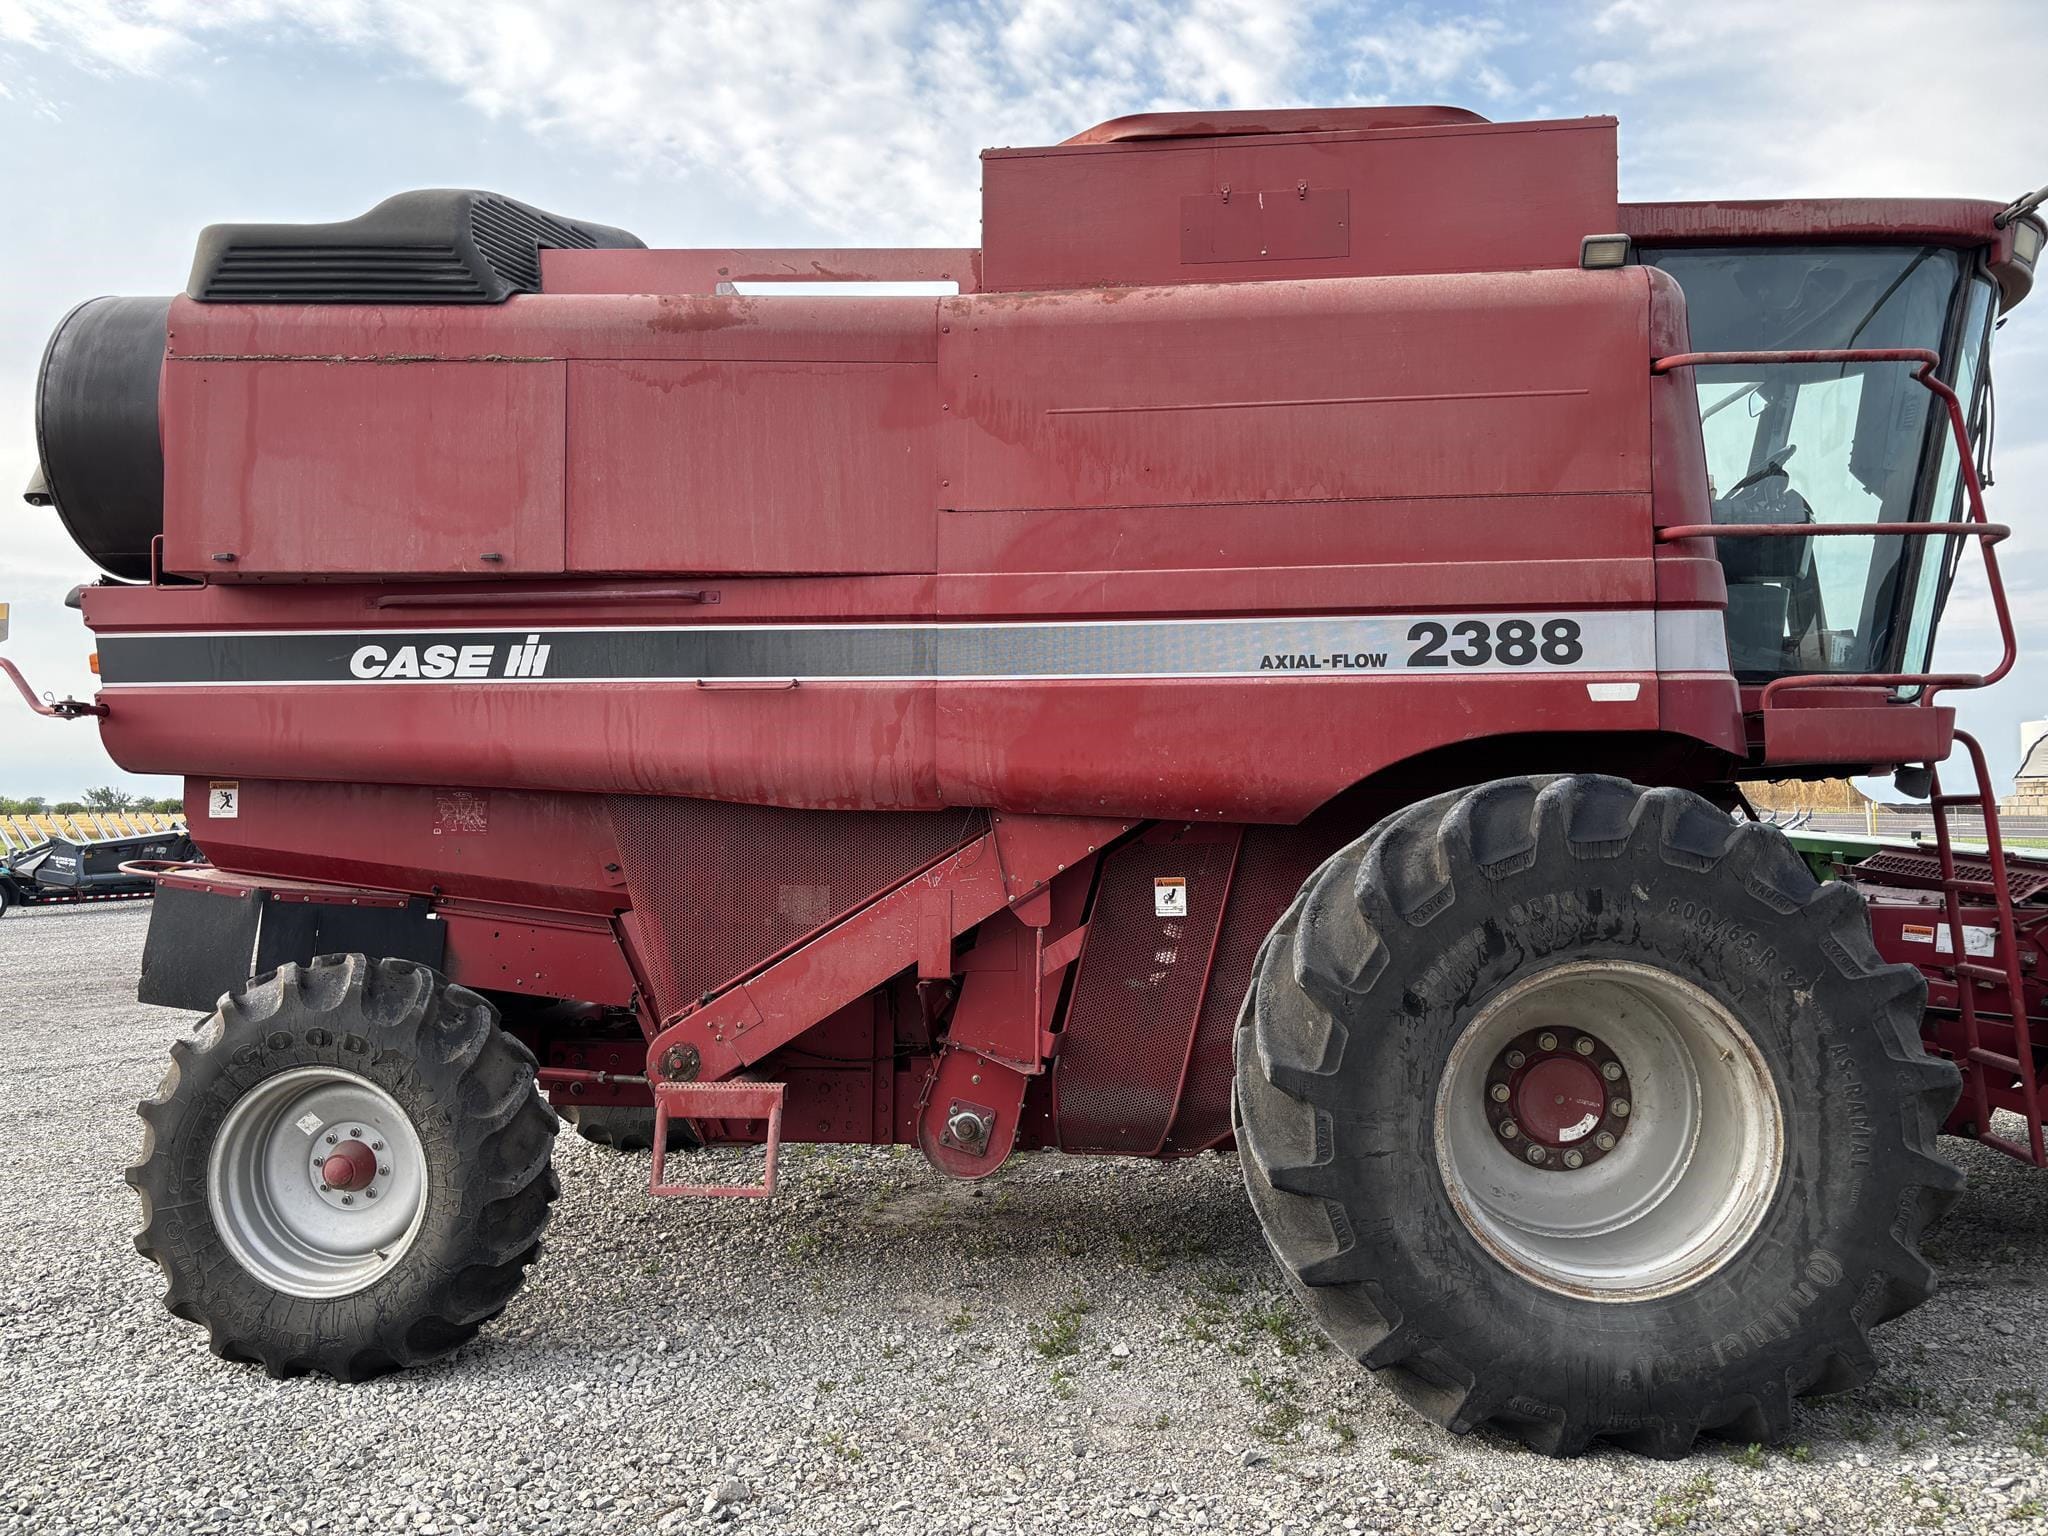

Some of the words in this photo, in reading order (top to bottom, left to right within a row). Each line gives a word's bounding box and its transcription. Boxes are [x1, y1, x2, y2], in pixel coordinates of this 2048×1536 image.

[350, 645, 495, 679] CASE
[1259, 653, 1388, 669] AXIAL-FLOW
[1407, 618, 1583, 667] 2388
[1668, 897, 1759, 949] 800/65
[1757, 946, 1777, 972] R
[1829, 1043, 1872, 1169] AS-RADIAL
